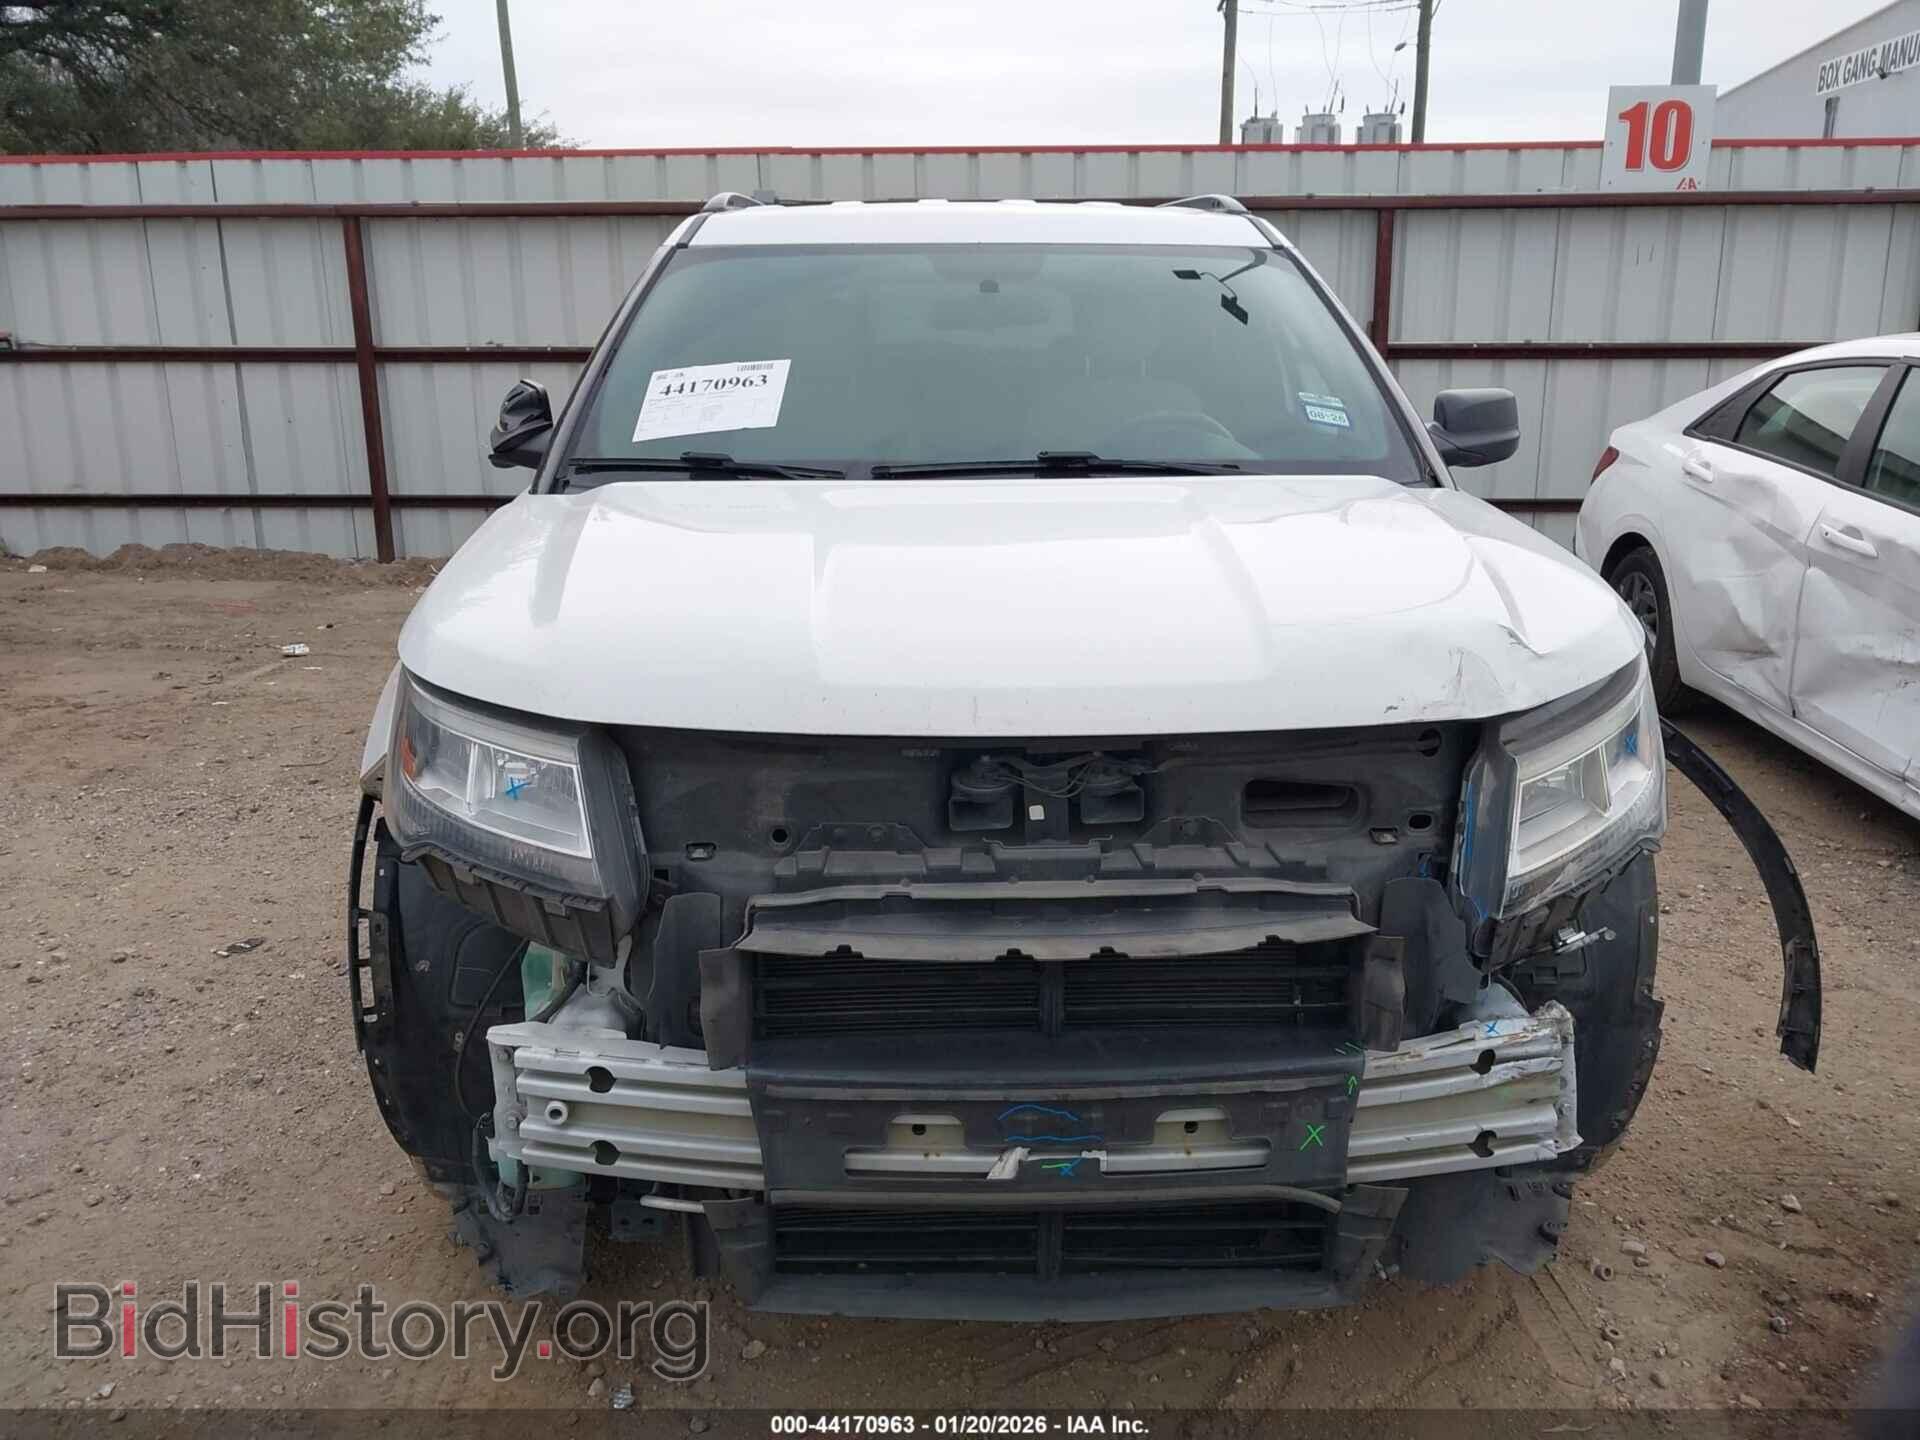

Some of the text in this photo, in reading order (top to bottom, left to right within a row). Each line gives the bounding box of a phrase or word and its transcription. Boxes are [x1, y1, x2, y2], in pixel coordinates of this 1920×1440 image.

[1817, 60, 1842, 93] BOX
[1842, 47, 1878, 85] GANG
[1618, 98, 1694, 172] 10
[658, 374, 768, 396] 44170963
